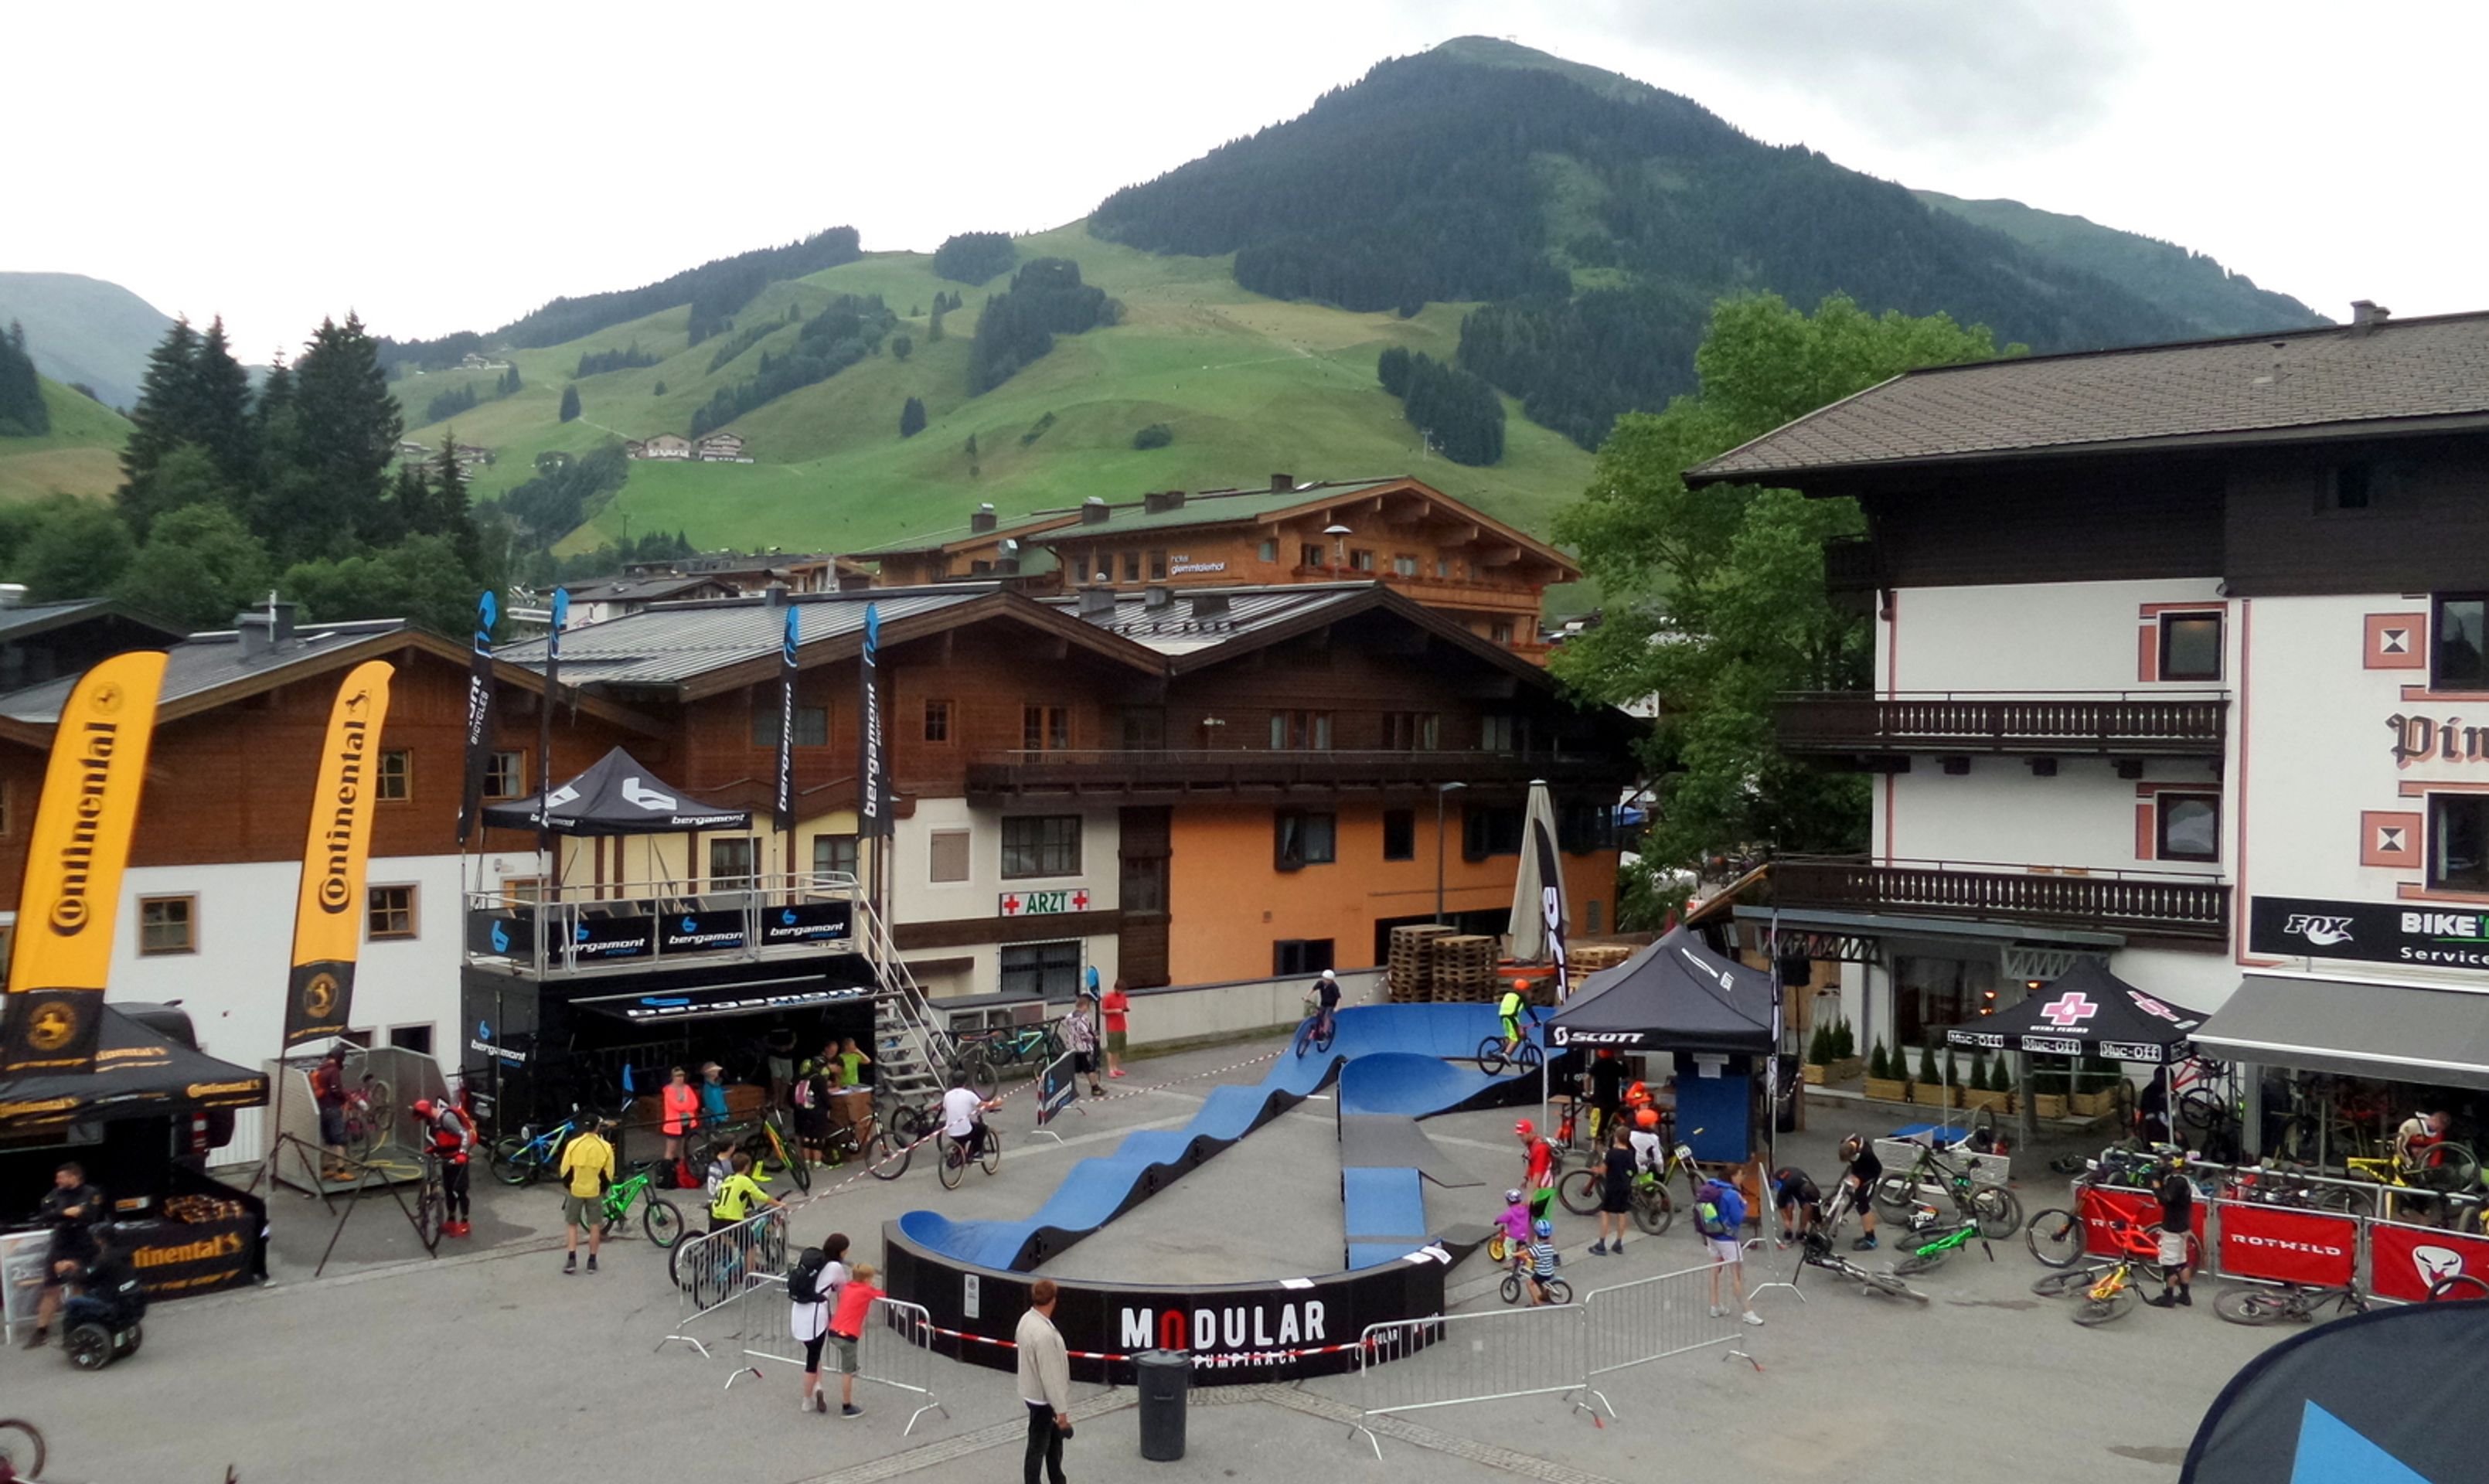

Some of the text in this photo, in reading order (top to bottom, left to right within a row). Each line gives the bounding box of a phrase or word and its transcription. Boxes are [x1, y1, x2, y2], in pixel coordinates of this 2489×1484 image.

[470, 690, 489, 745] BICYCLES
[863, 682, 881, 819] bergamont
[319, 720, 366, 915] Continental
[671, 813, 746, 825] bergamont
[49, 721, 117, 938] Continental
[1026, 892, 1067, 914] ARZT
[770, 922, 844, 937] bergamont
[2283, 914, 2354, 945] FOX
[1570, 1032, 1644, 1043] SCOTT
[2103, 1043, 2158, 1060] Muc-Off
[2231, 1233, 2341, 1256] ROTWILD
[1121, 1300, 1325, 1350] MODULAR
[1194, 1349, 1297, 1369] PUMPTRACK
